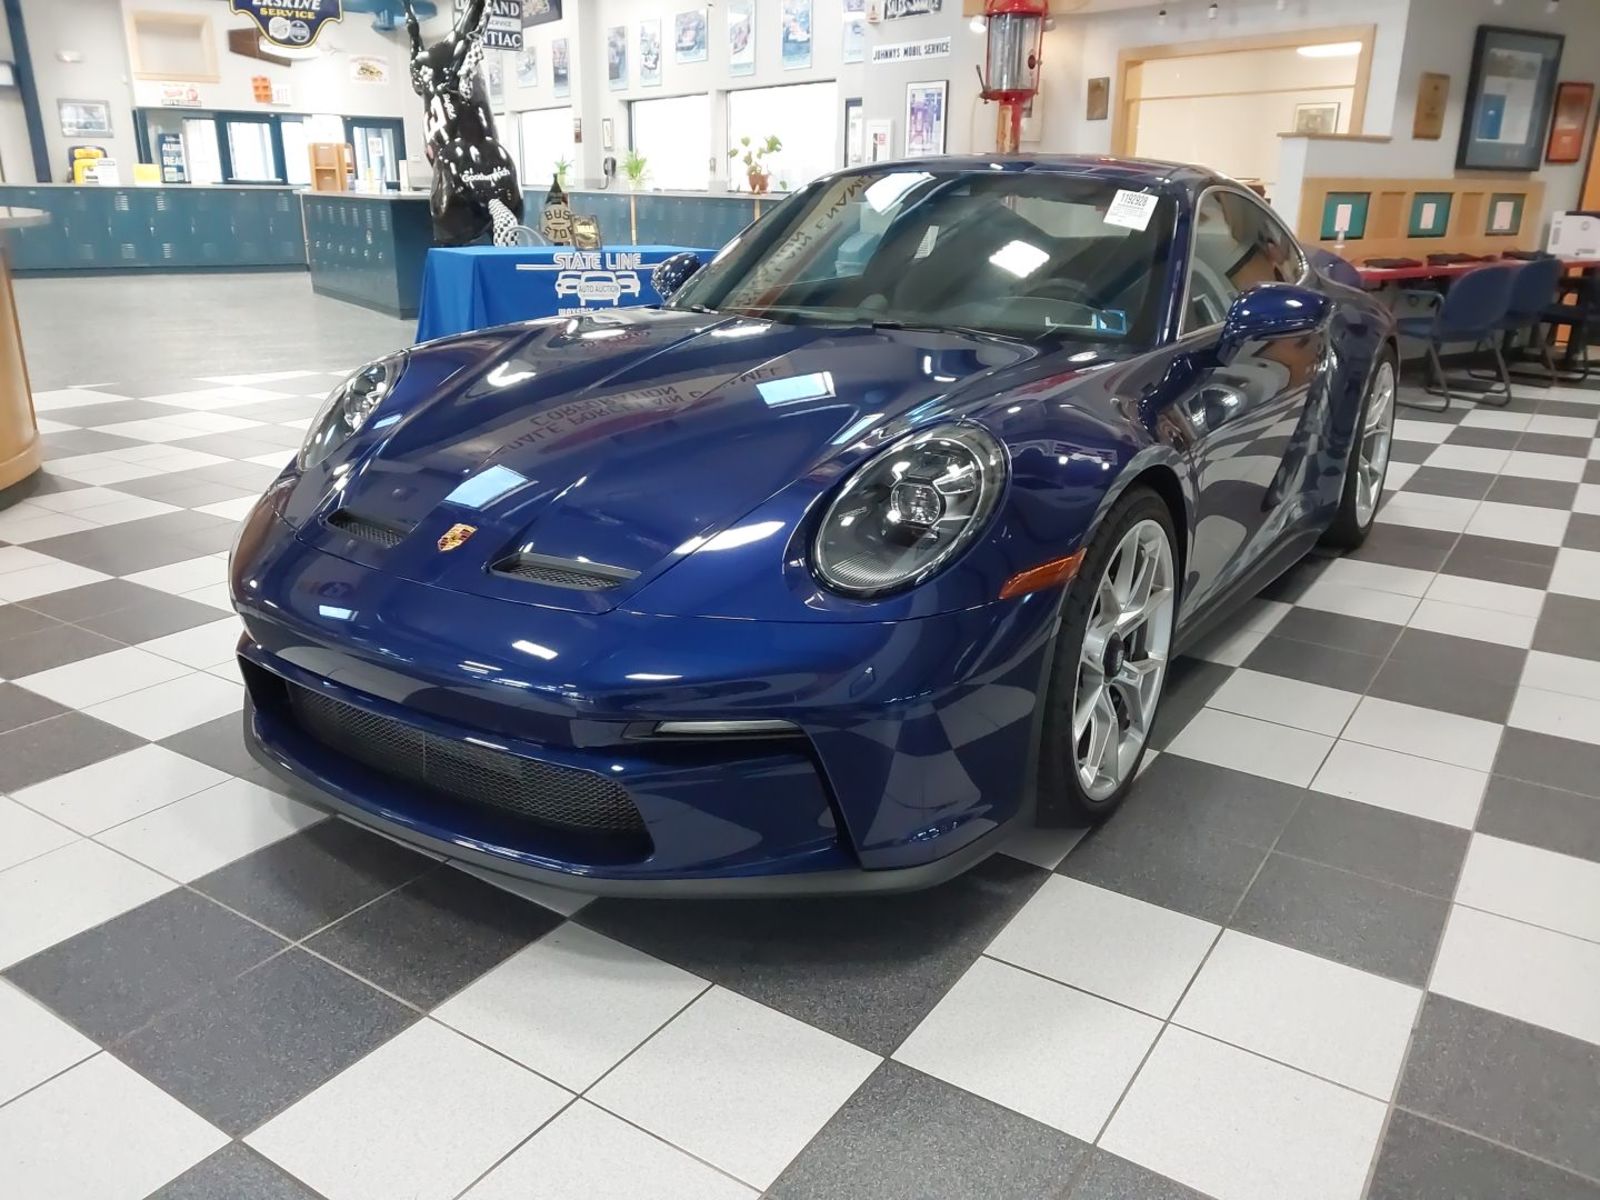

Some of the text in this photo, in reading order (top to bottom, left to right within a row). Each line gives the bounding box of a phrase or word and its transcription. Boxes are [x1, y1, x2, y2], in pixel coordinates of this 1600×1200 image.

[260, 7, 315, 19] SERVICE
[924, 41, 950, 55] SERVICE
[545, 209, 571, 221] BUS
[553, 252, 642, 270] STATE LINE
